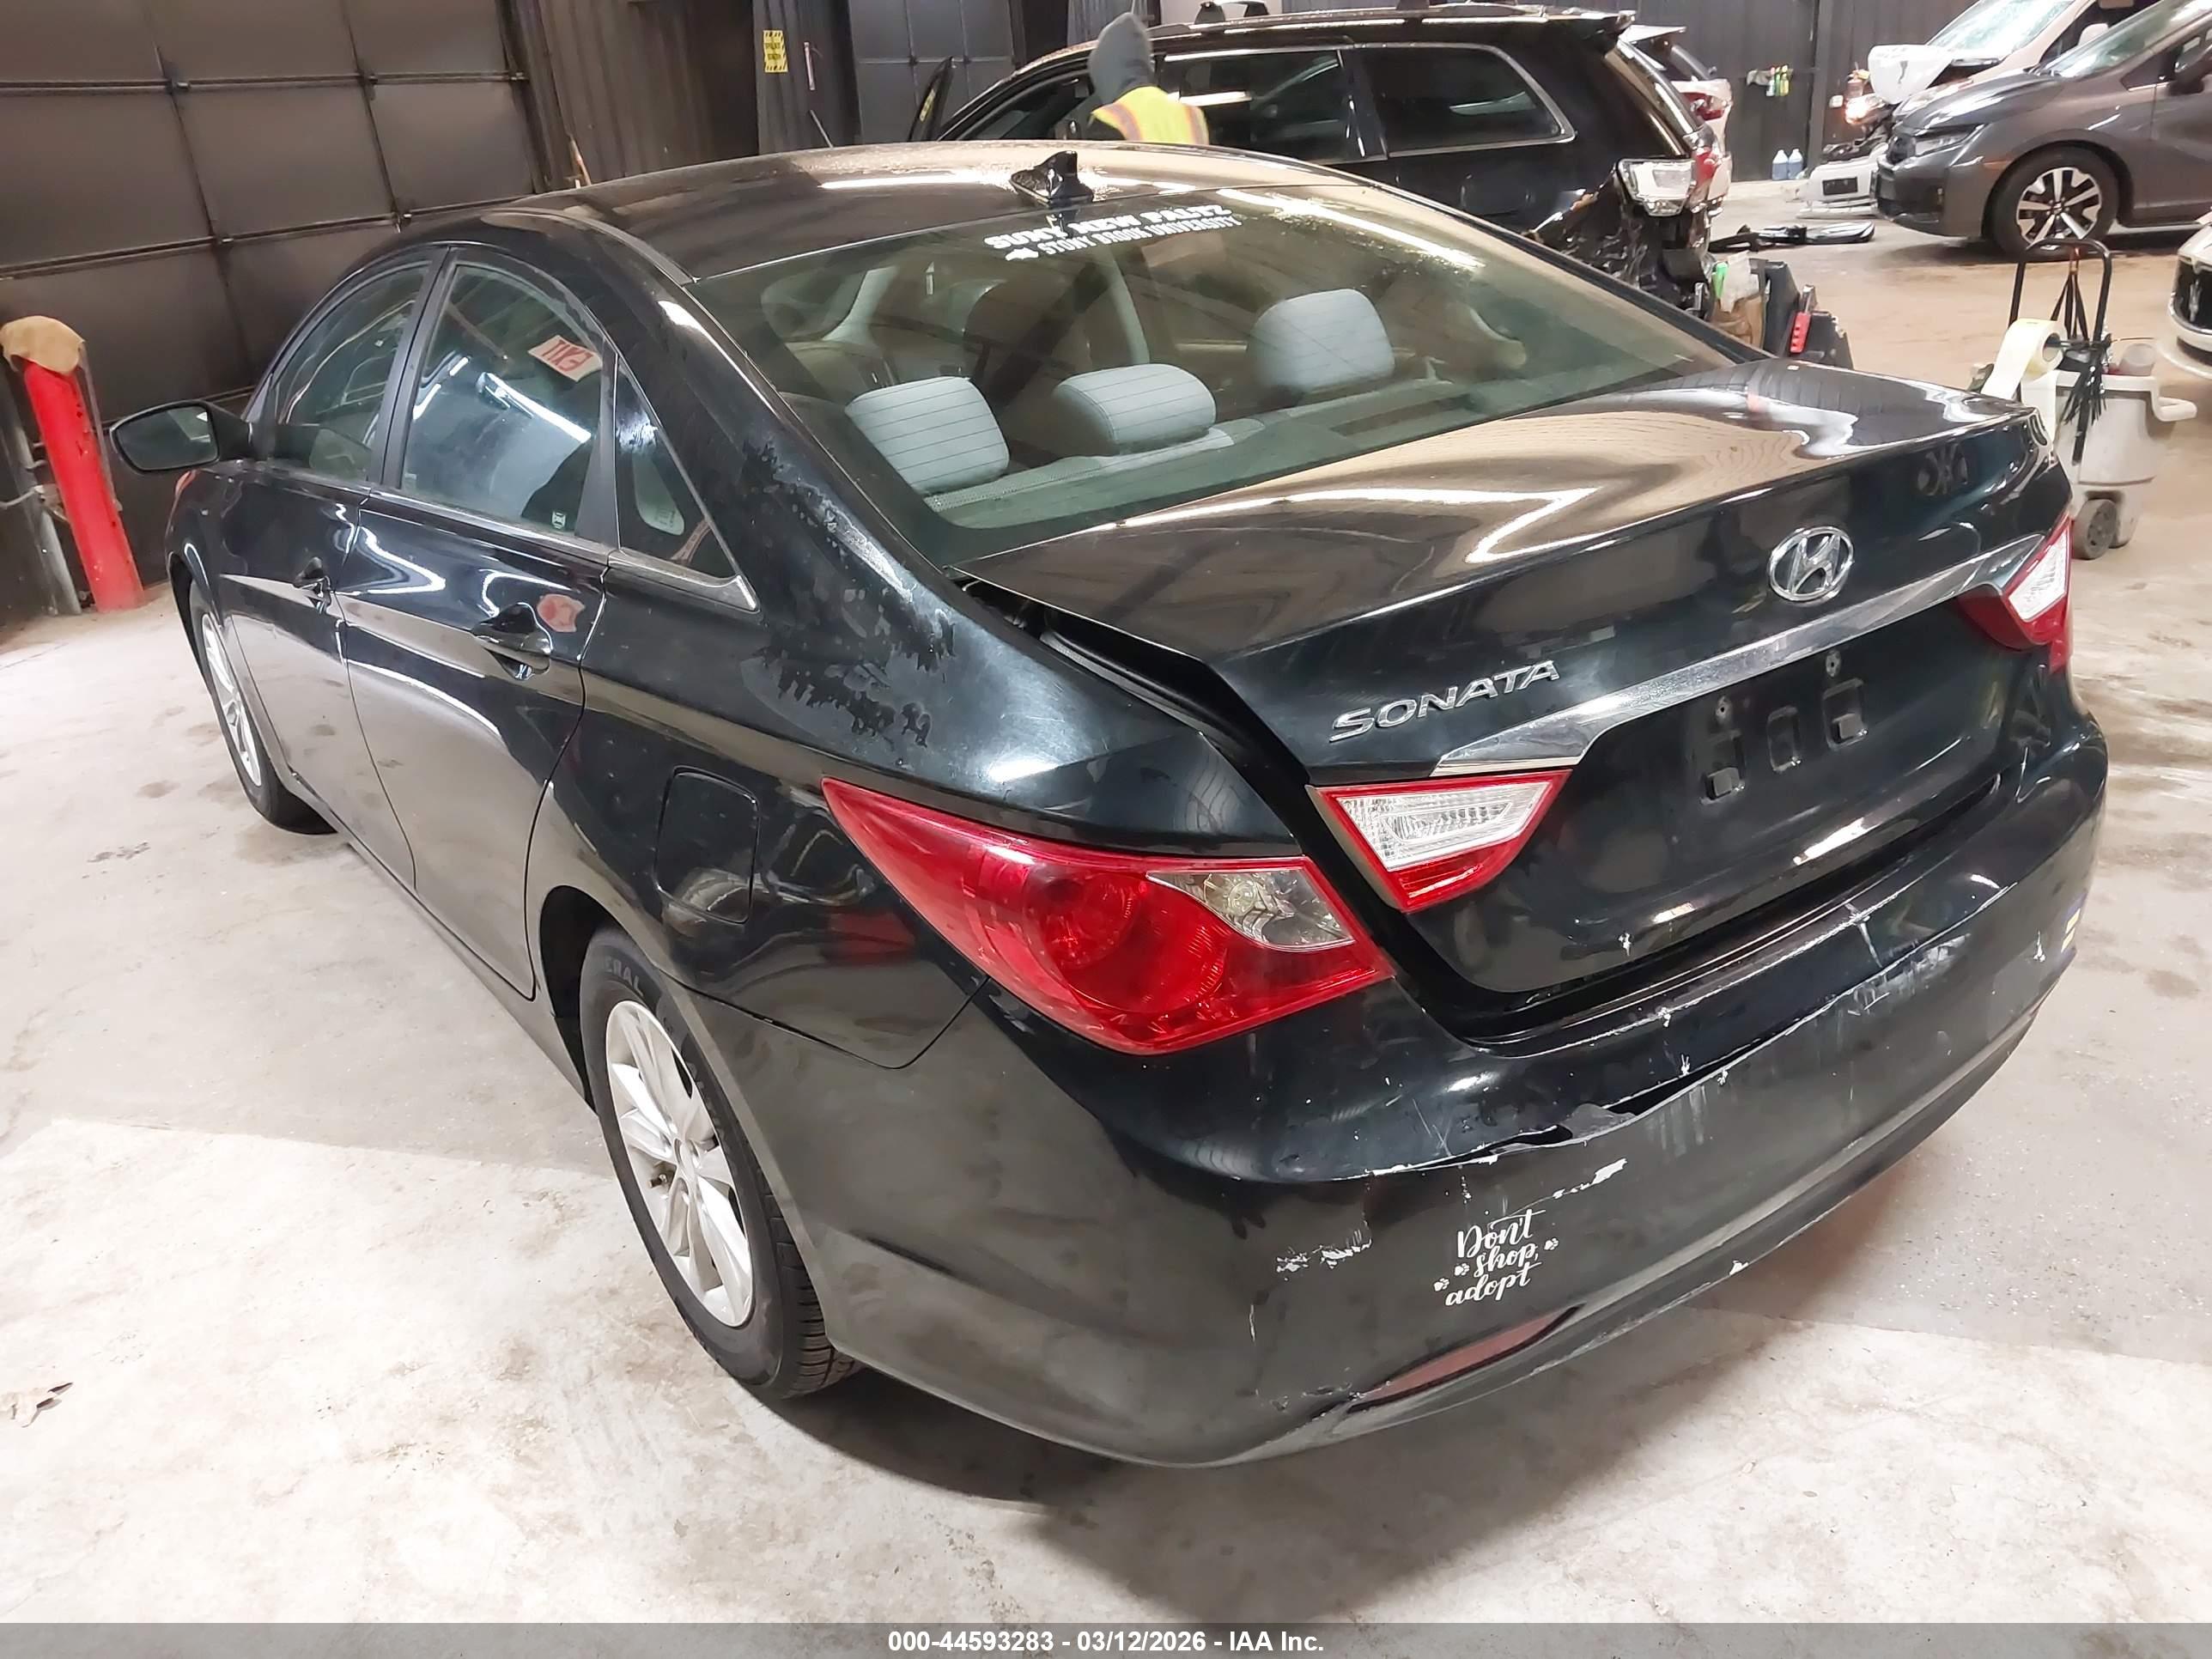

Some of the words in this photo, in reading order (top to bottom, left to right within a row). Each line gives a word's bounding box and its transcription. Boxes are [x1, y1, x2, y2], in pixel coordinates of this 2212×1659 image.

[984, 226, 1068, 248] SUNY
[1067, 215, 1142, 234] NEW
[1139, 204, 1232, 223] PALTZ
[1036, 236, 1097, 254] STONY
[1091, 227, 1153, 246] BROOK
[1144, 216, 1242, 235] UNIVERSITY
[1329, 659, 1559, 742] SONATA
[1457, 1208, 1546, 1258] Don't
[1444, 1261, 1542, 1306] adopt
